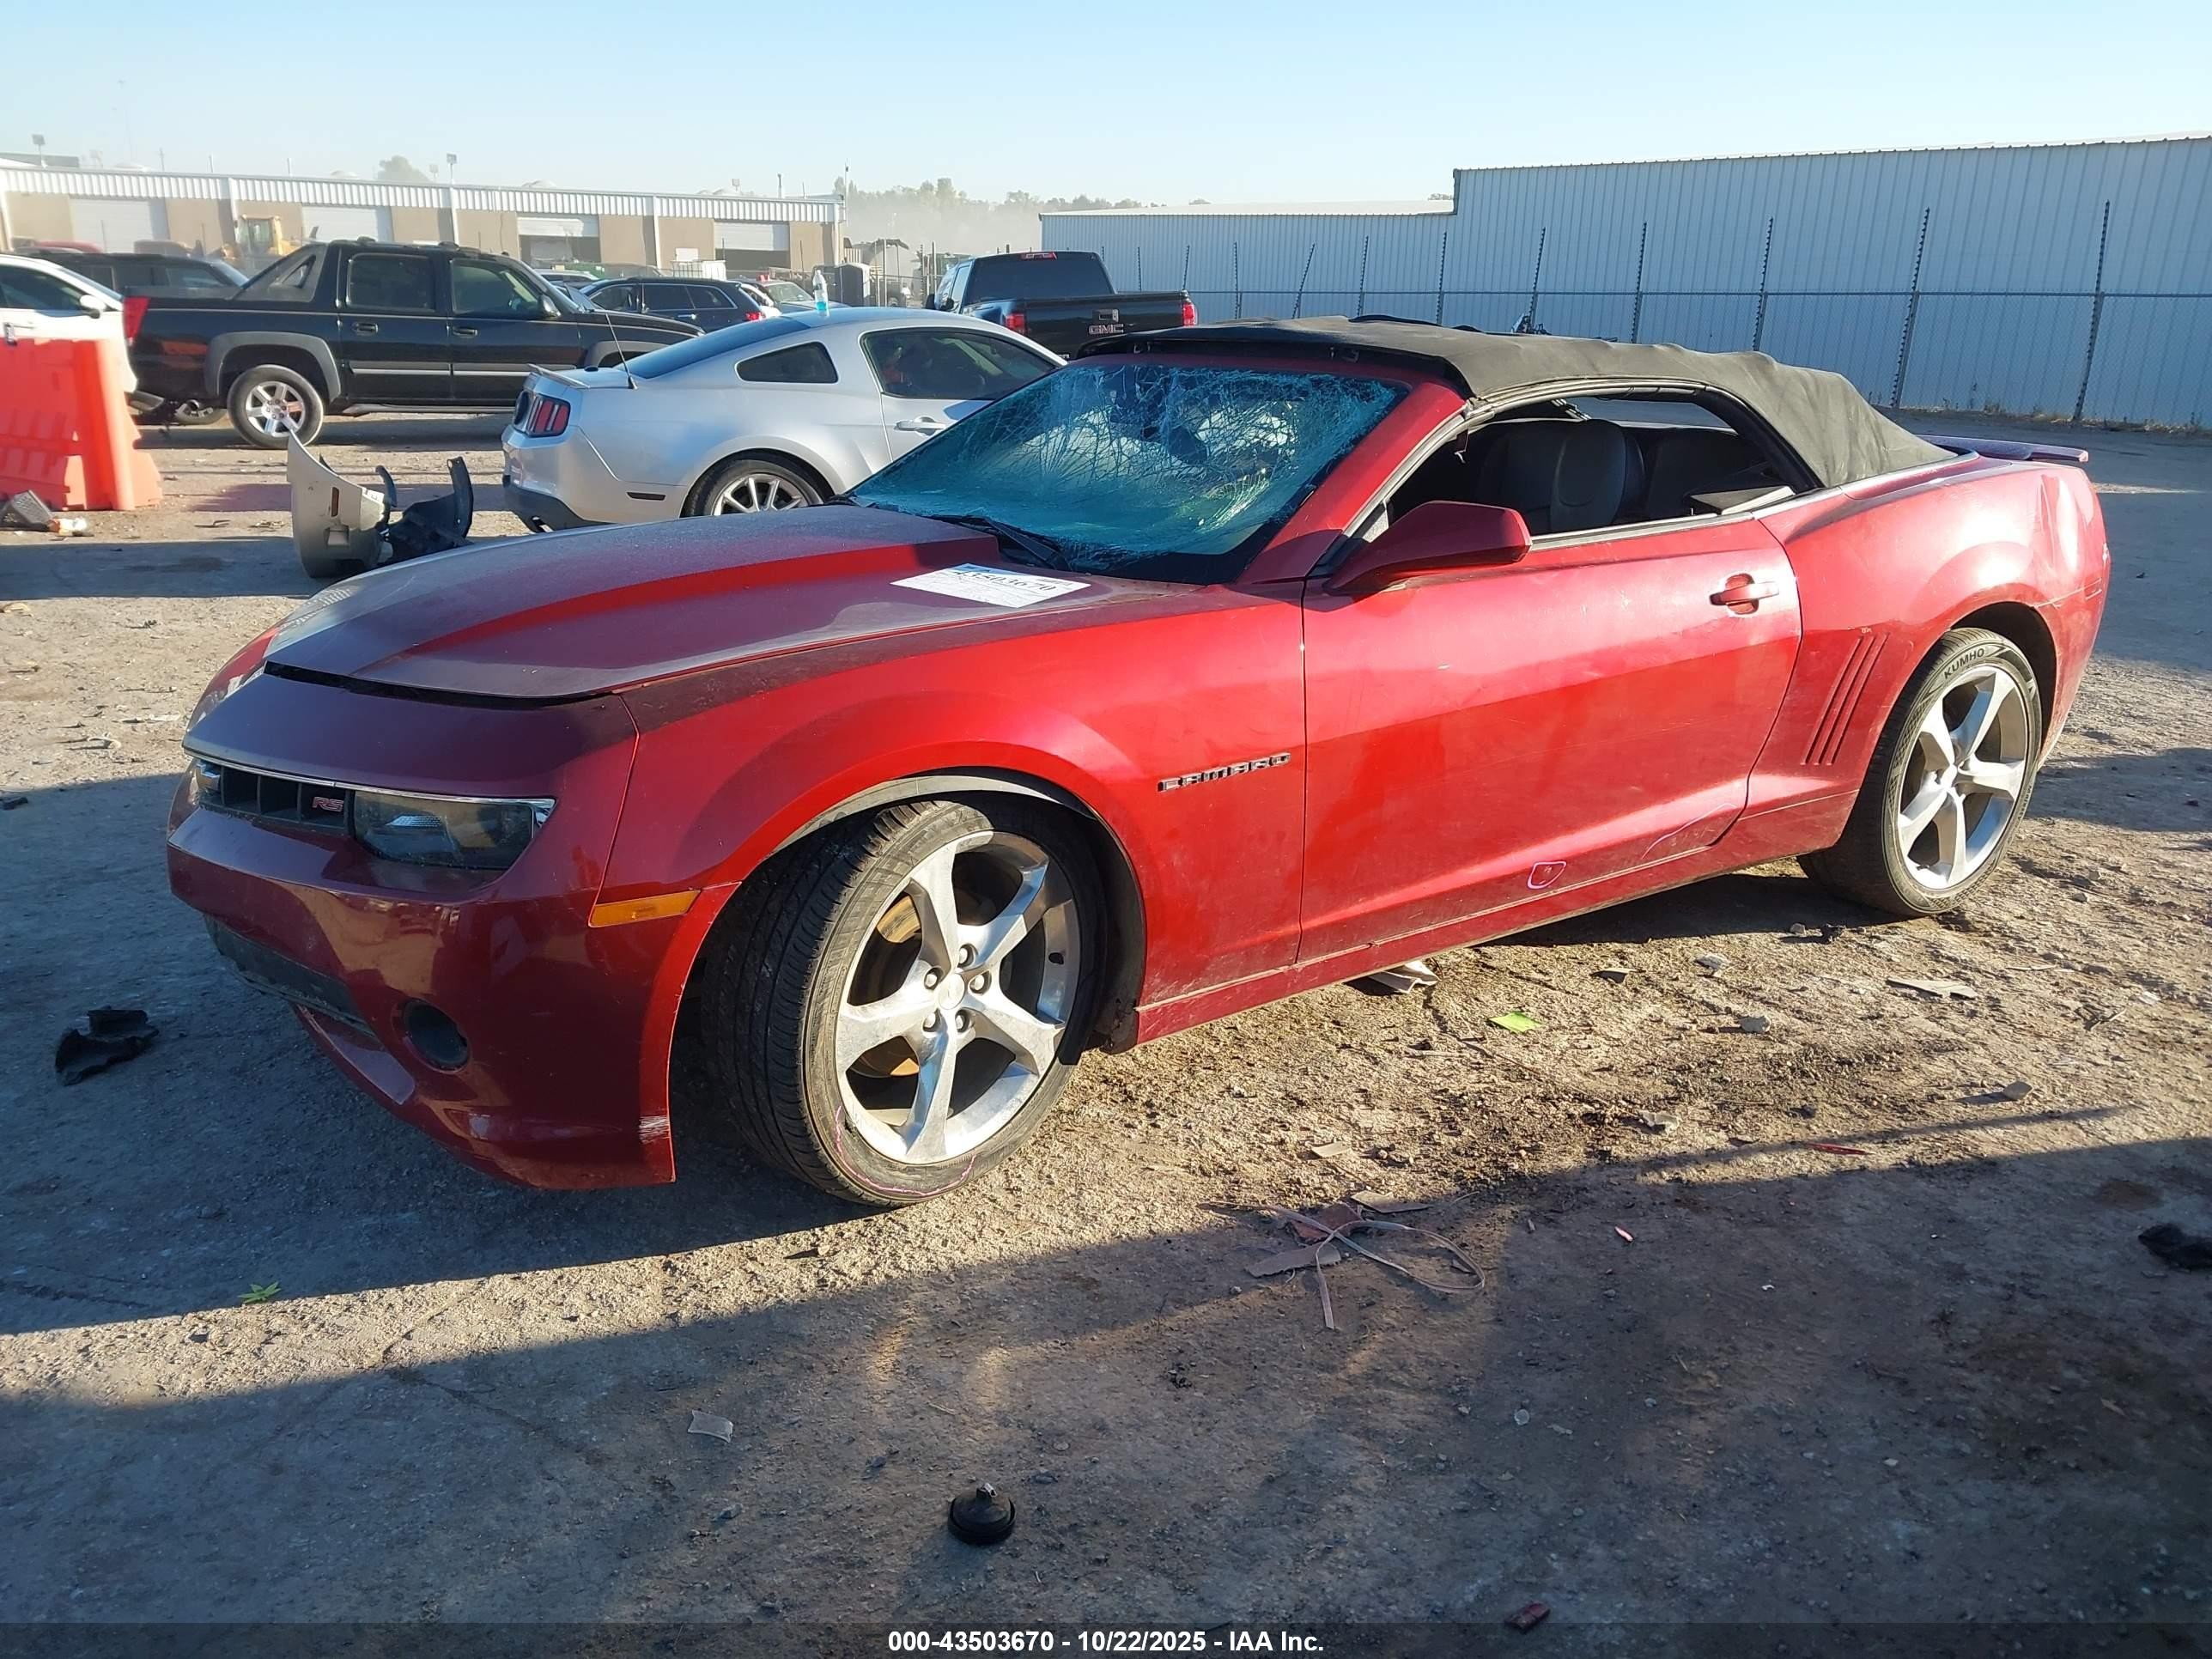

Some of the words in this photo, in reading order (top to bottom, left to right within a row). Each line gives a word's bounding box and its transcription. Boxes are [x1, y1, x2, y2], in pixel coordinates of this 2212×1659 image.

[1088, 323, 1124, 335] GMC
[1944, 647, 1984, 679] KUMHO
[1158, 752, 1291, 793] CAMARO
[312, 796, 344, 812] RS
